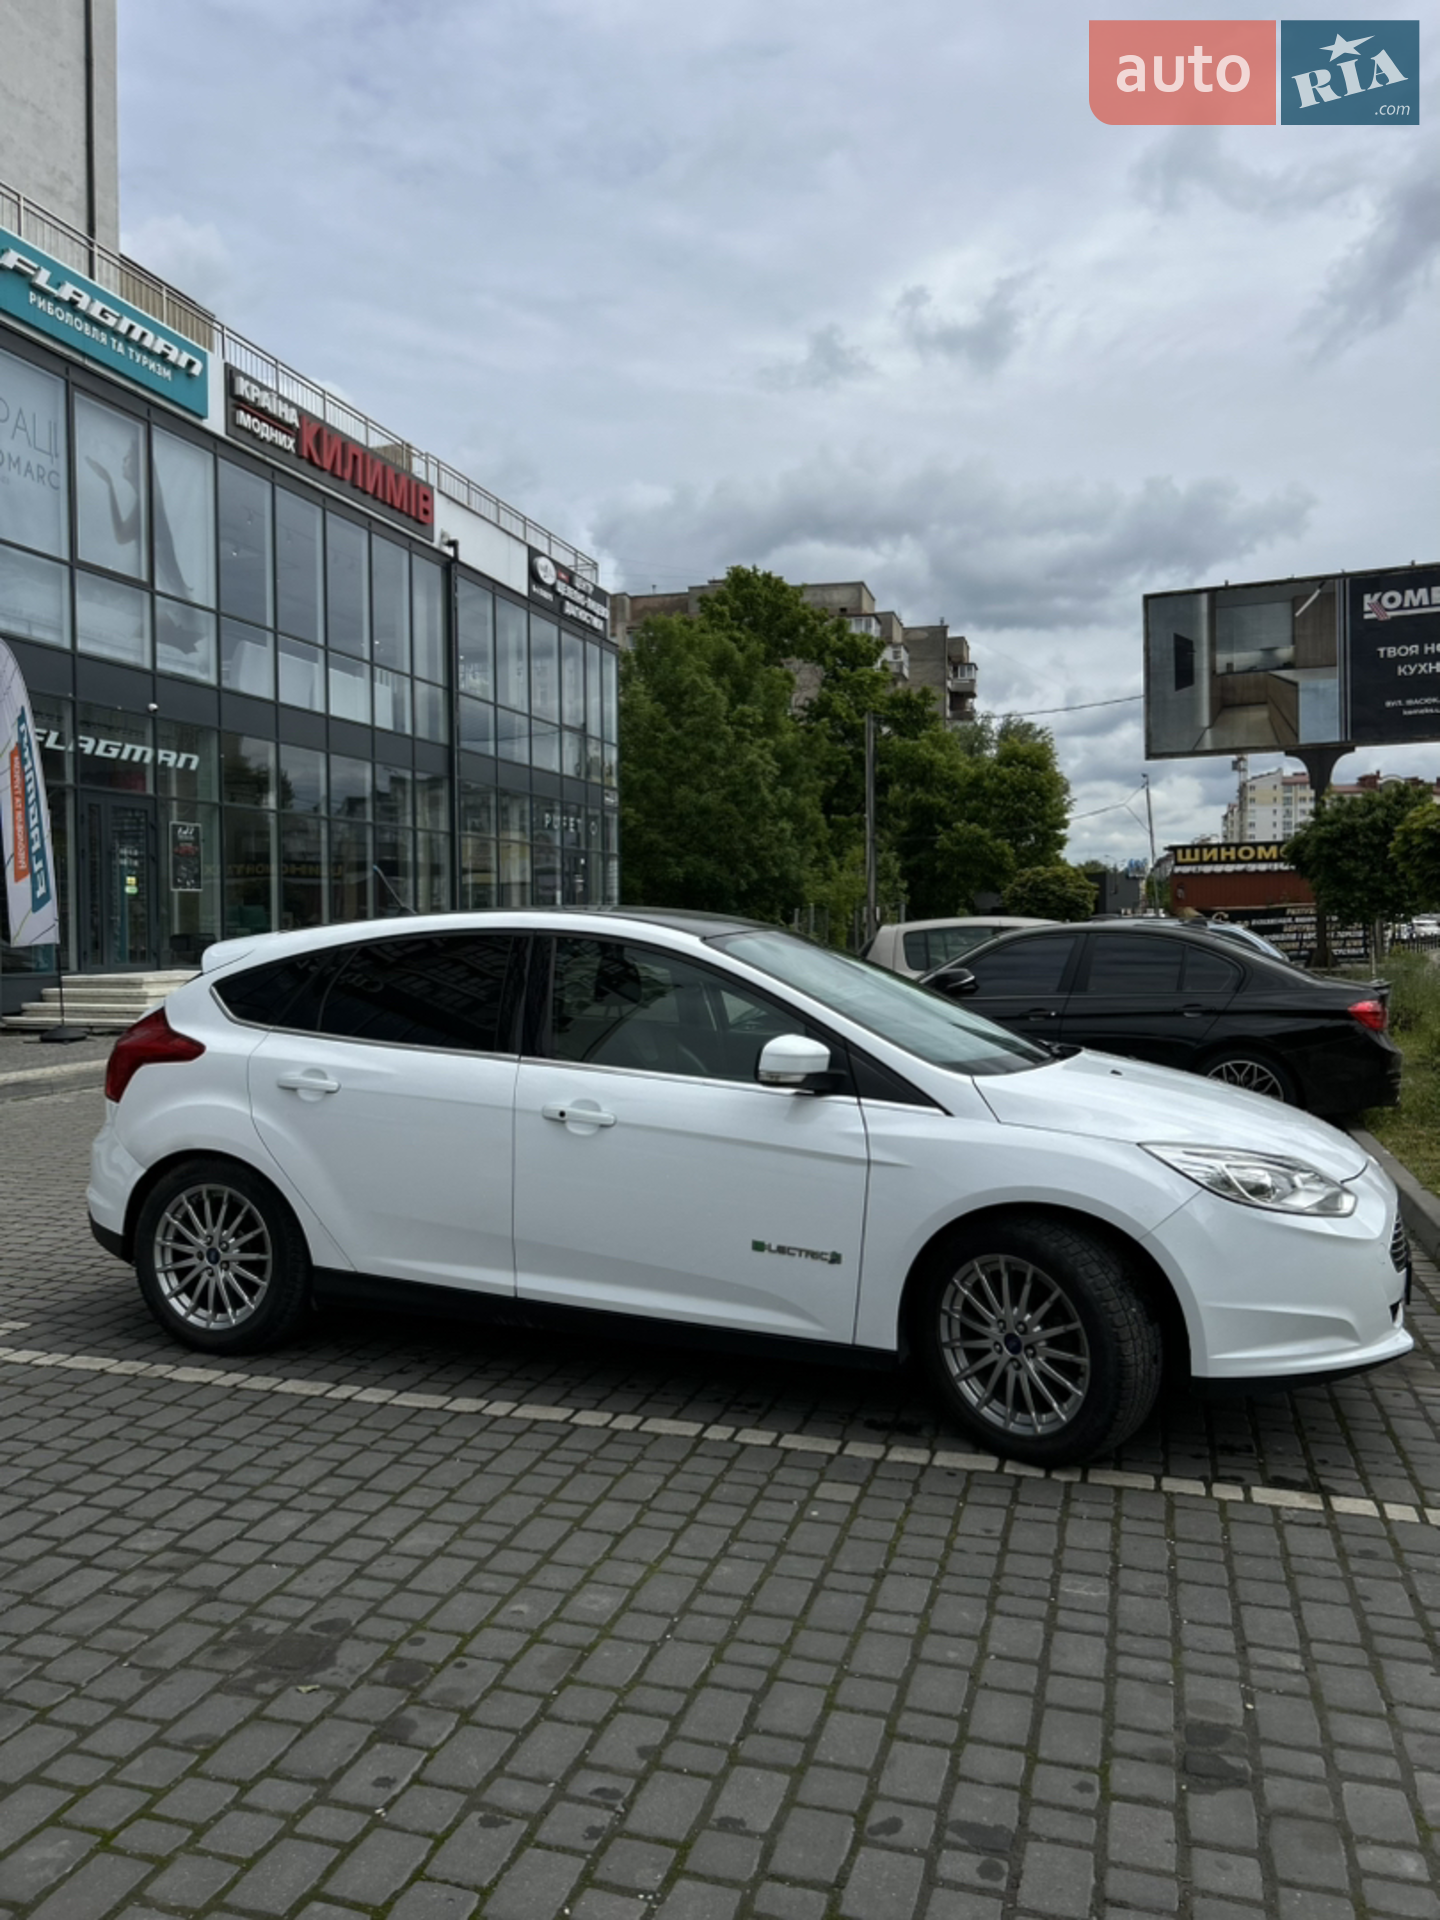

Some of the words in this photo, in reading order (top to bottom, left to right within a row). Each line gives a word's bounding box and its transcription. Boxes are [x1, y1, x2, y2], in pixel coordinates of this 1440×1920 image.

[0, 249, 203, 376] FLAGMAN
[29, 291, 107, 346] РИБОЛОВЛЯ
[111, 339, 125, 355] ТА
[129, 347, 172, 381] ТУРИЗМ
[235, 376, 299, 428] КРАЇНА
[236, 409, 296, 453] МОДНИХ
[300, 416, 434, 525] КИЛИМІВ
[1377, 644, 1419, 658] ТВОЯ
[34, 728, 199, 771] FLAGMAN
